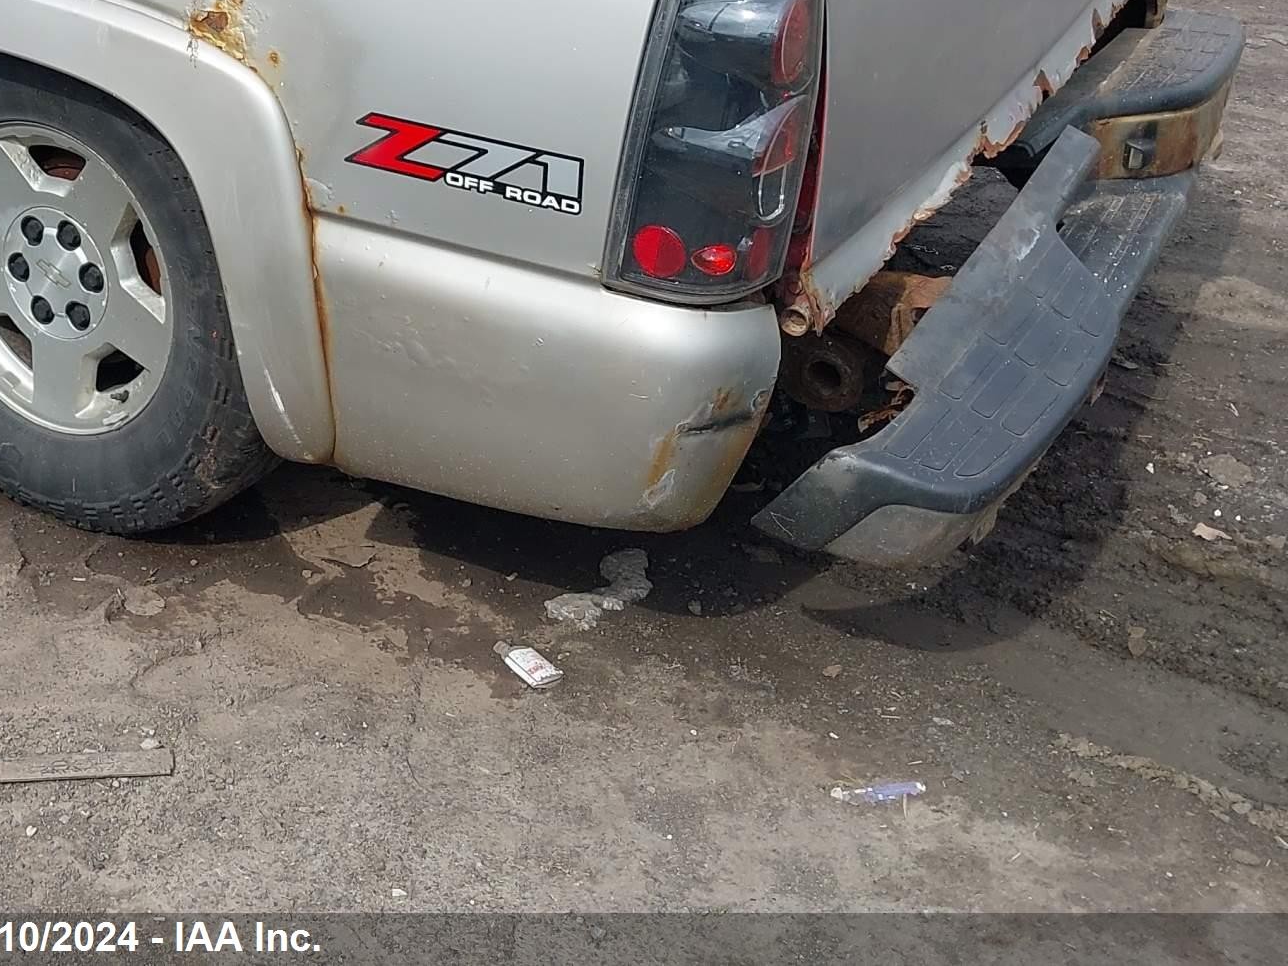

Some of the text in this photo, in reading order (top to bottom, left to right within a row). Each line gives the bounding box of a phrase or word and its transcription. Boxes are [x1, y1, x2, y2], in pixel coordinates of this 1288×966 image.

[344, 112, 584, 201] Z71
[445, 172, 581, 214] OFF ROAD
